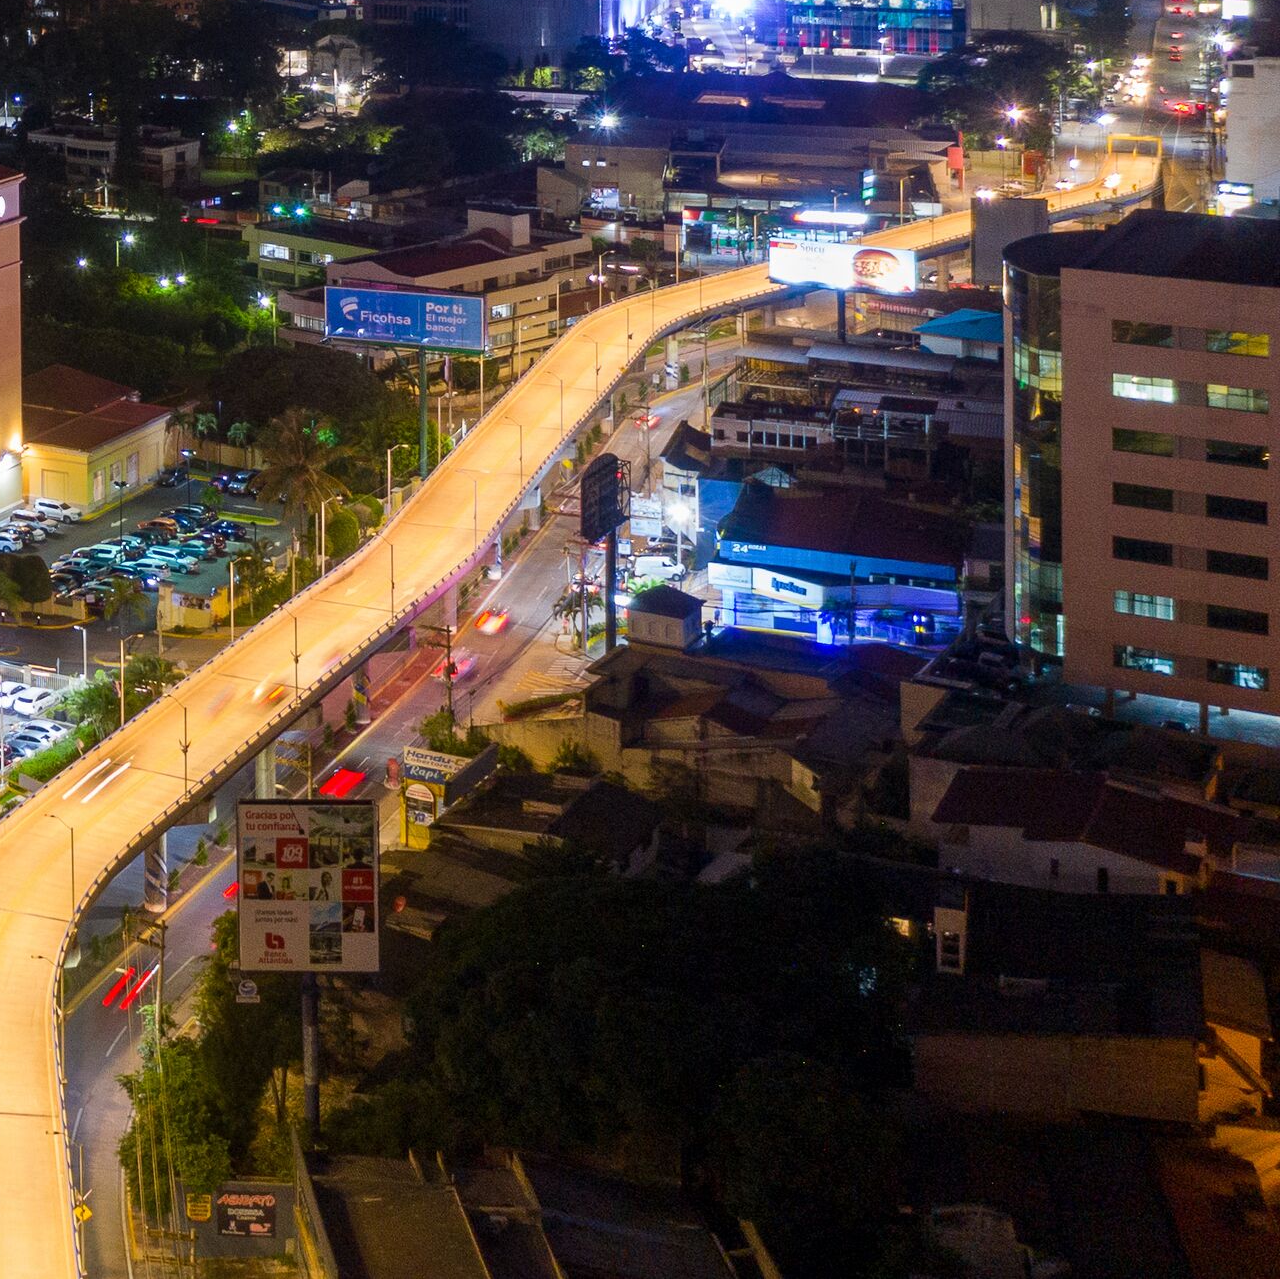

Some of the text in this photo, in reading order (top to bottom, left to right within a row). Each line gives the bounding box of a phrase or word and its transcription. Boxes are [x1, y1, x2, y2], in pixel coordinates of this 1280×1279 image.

[426, 302, 466, 315] Por ti.
[360, 311, 411, 325] Ficohsa
[426, 314, 467, 325] El mejor
[426, 323, 456, 333] banco
[732, 544, 748, 553] 24
[245, 811, 296, 822] Gracias por
[246, 822, 301, 831] tu confianza
